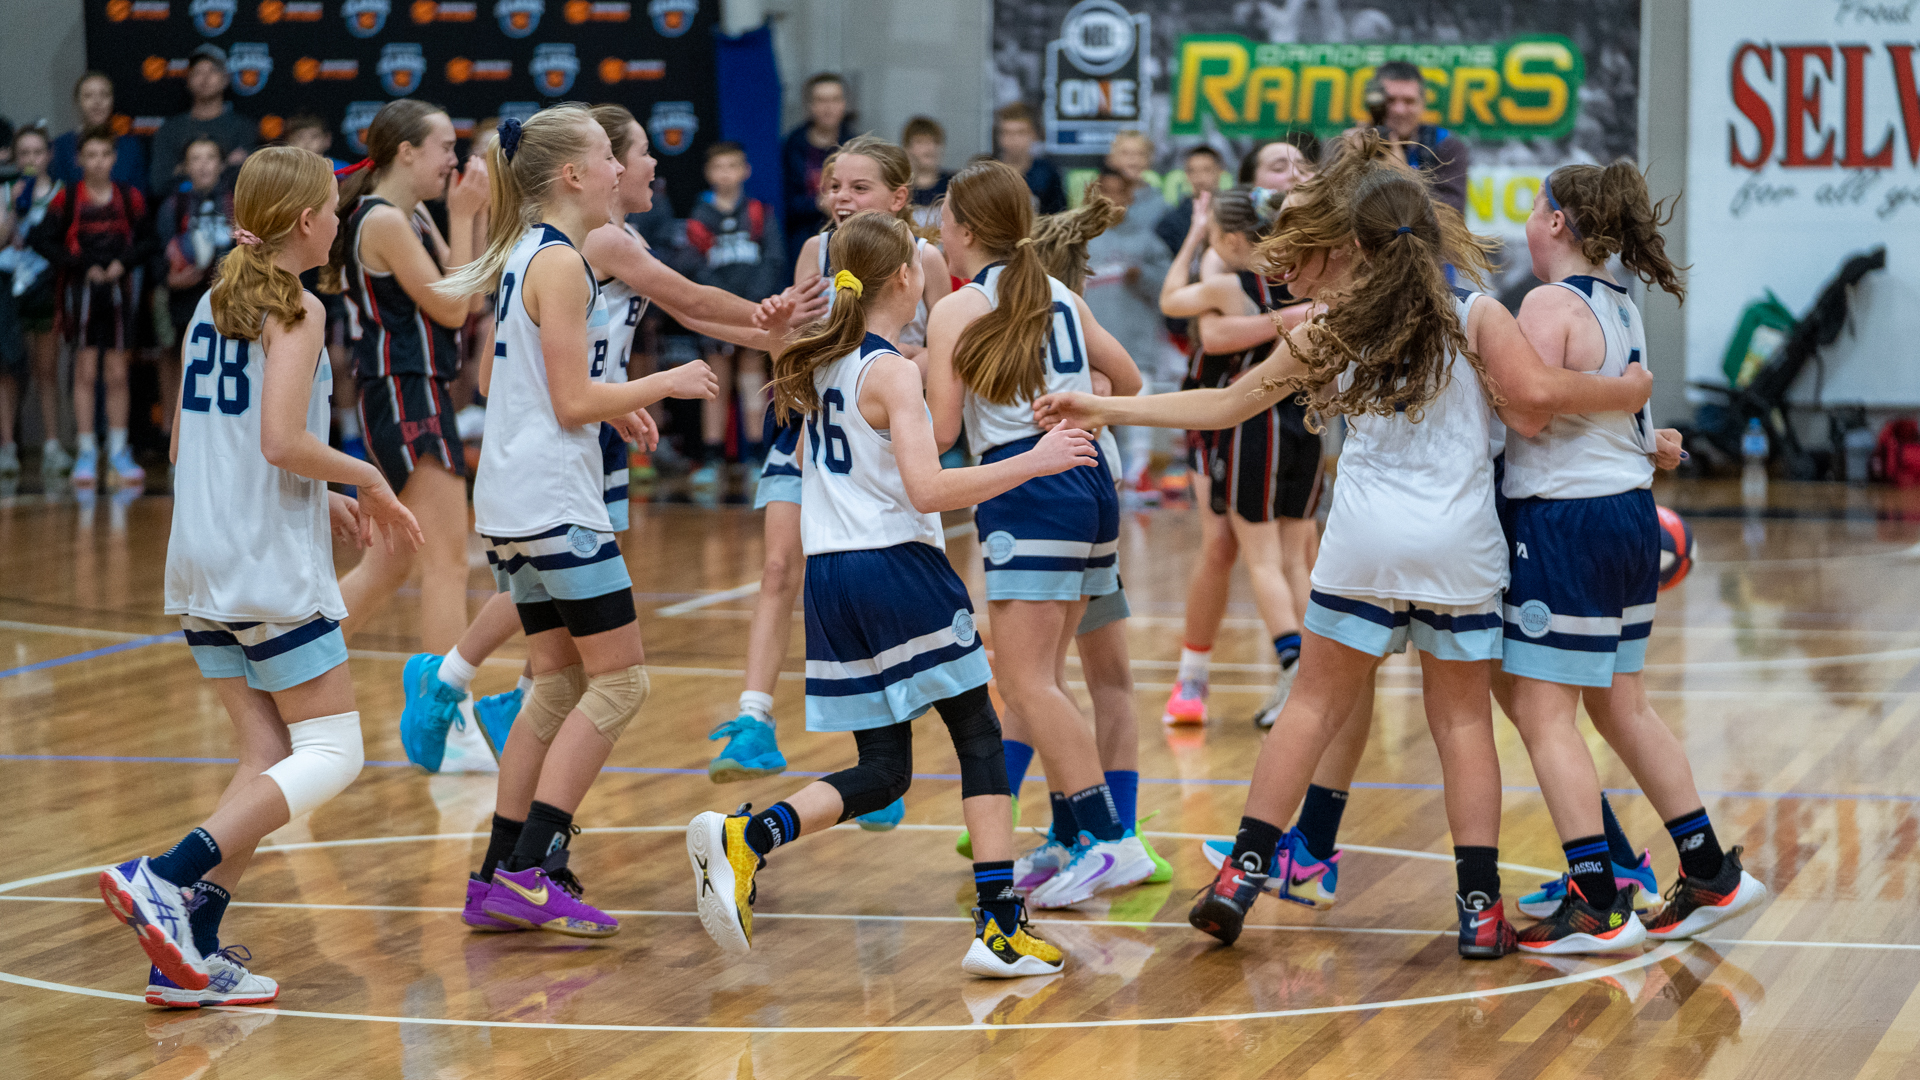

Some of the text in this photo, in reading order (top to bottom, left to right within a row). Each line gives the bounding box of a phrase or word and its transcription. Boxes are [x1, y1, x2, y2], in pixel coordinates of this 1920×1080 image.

[1060, 79, 1137, 118] ONE
[1042, 300, 1084, 374] 0
[182, 321, 251, 417] 28
[763, 817, 782, 849] CLASS
